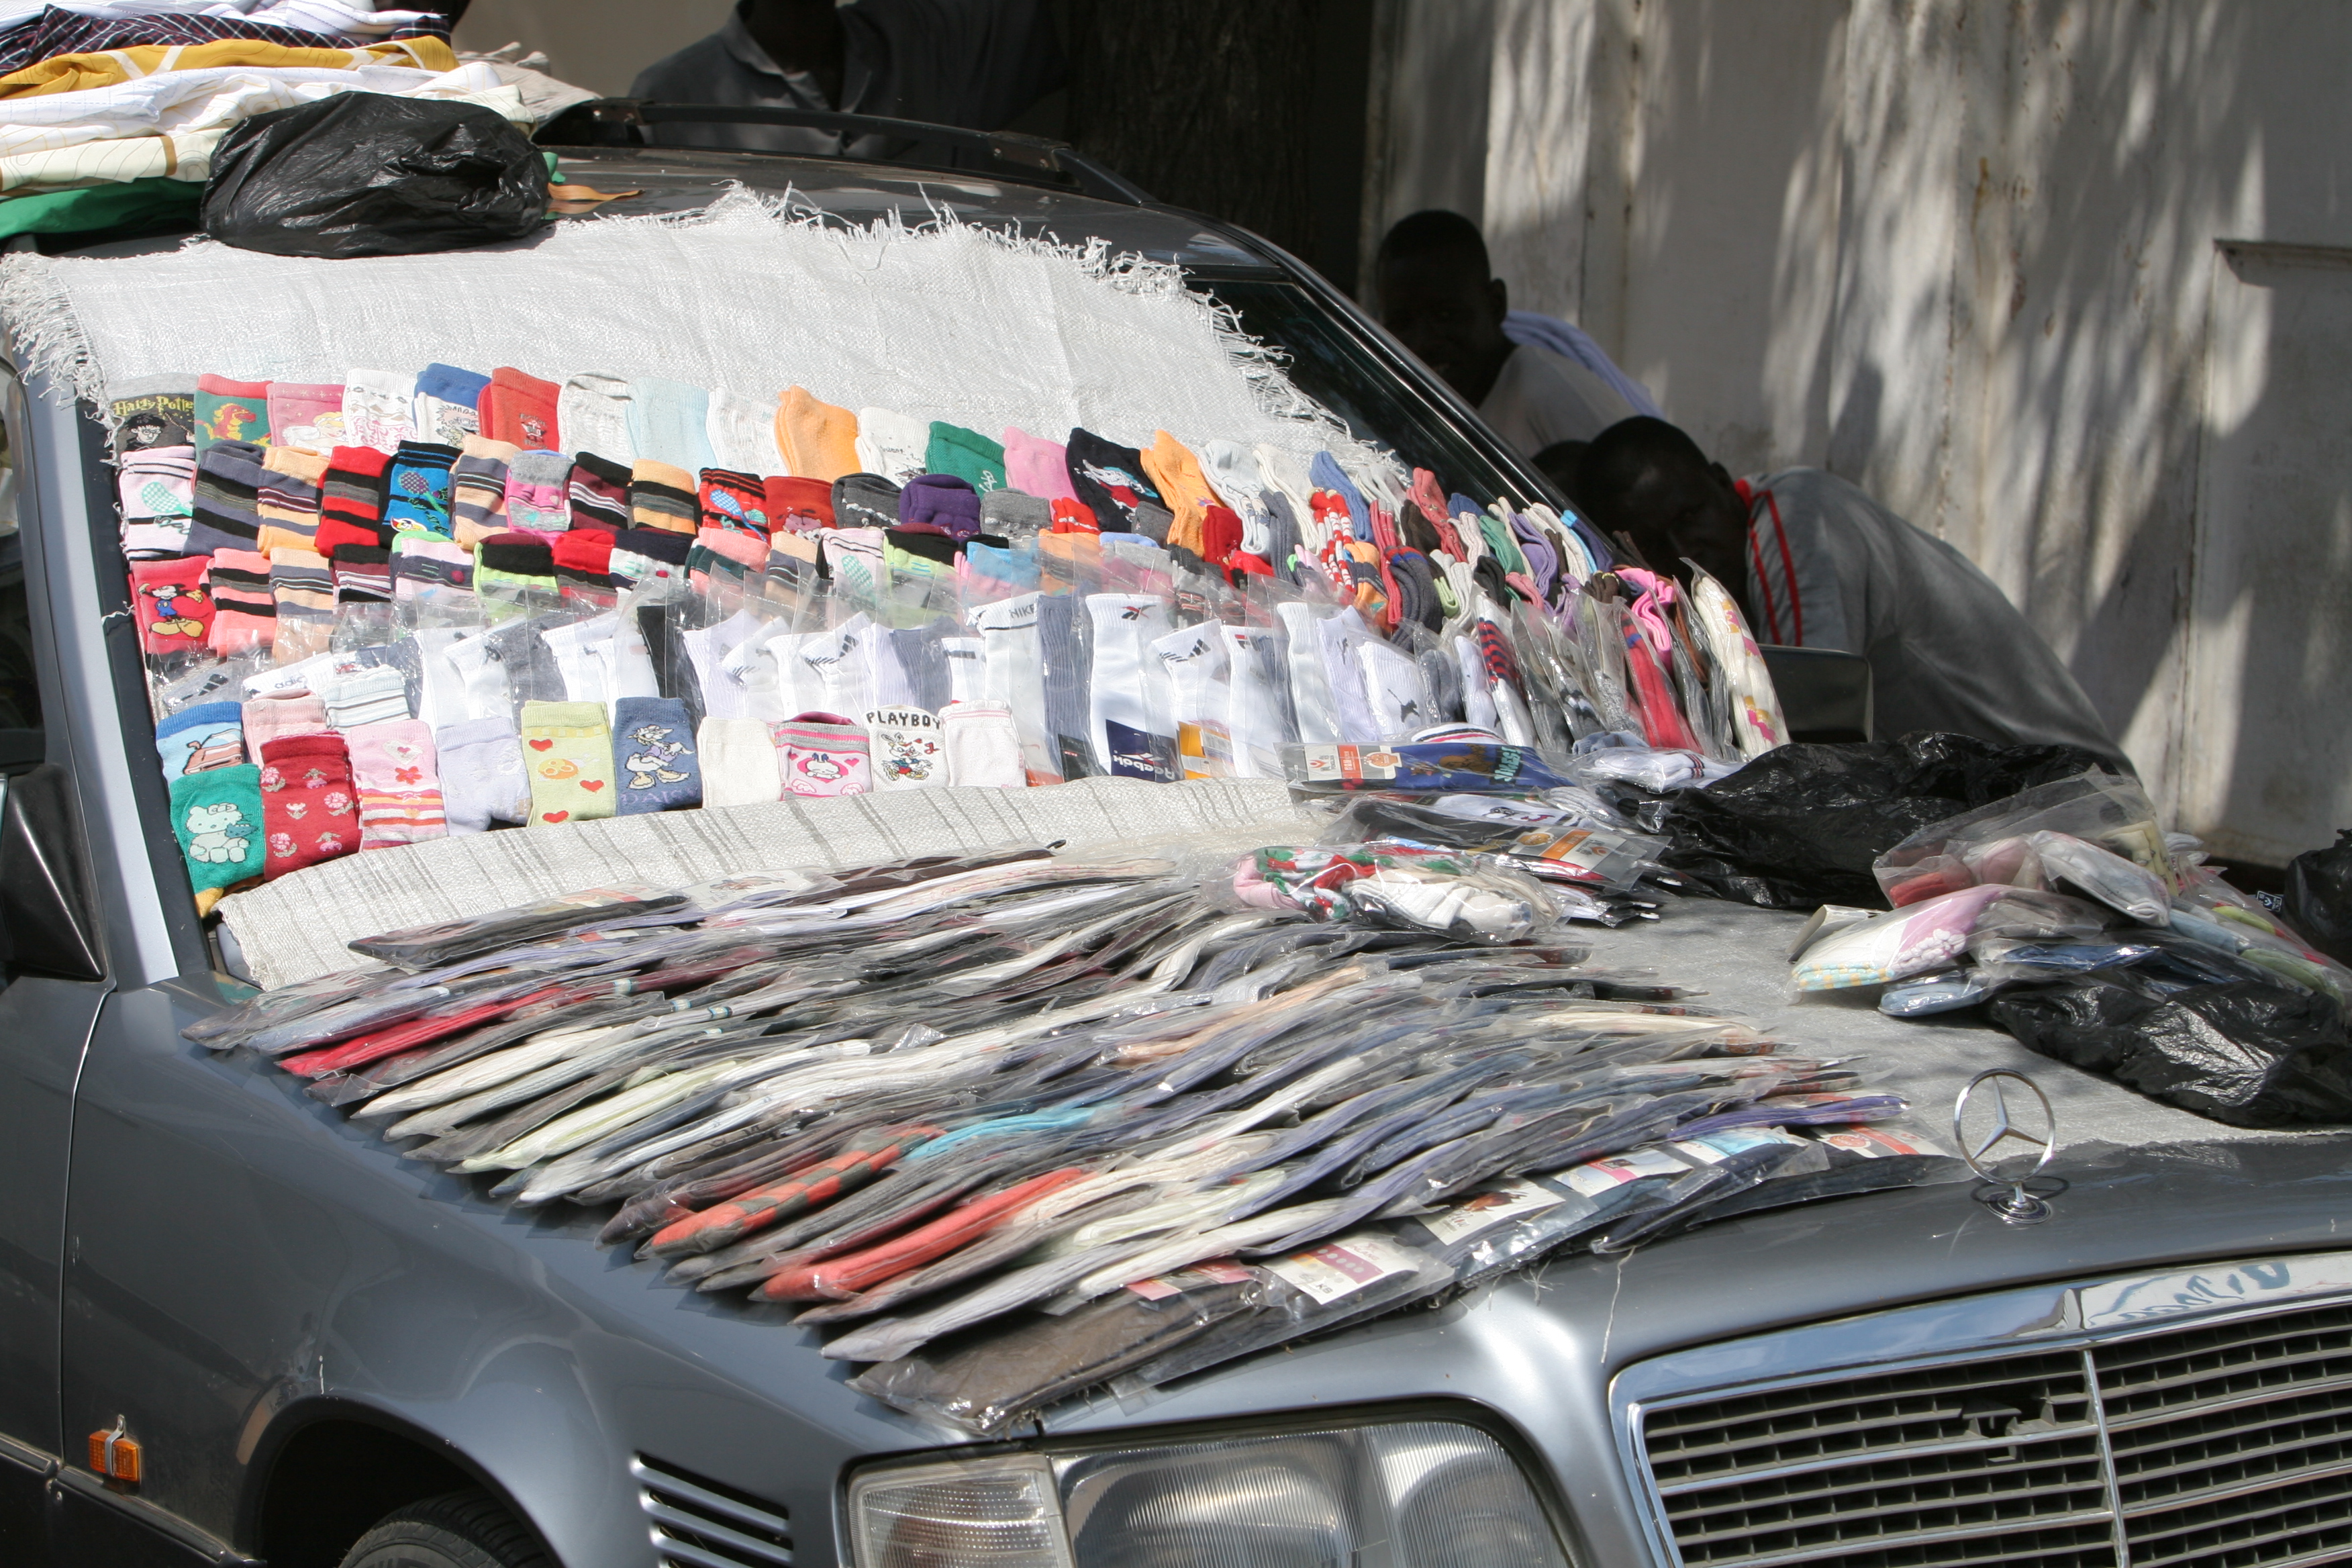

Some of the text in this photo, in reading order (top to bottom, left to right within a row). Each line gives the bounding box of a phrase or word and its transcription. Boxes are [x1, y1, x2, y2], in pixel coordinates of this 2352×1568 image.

[155, 395, 195, 416] Potte
[1008, 603, 1035, 618] NIKE
[866, 709, 941, 730] PLAYBOY
[1112, 754, 1176, 781] Reebok
